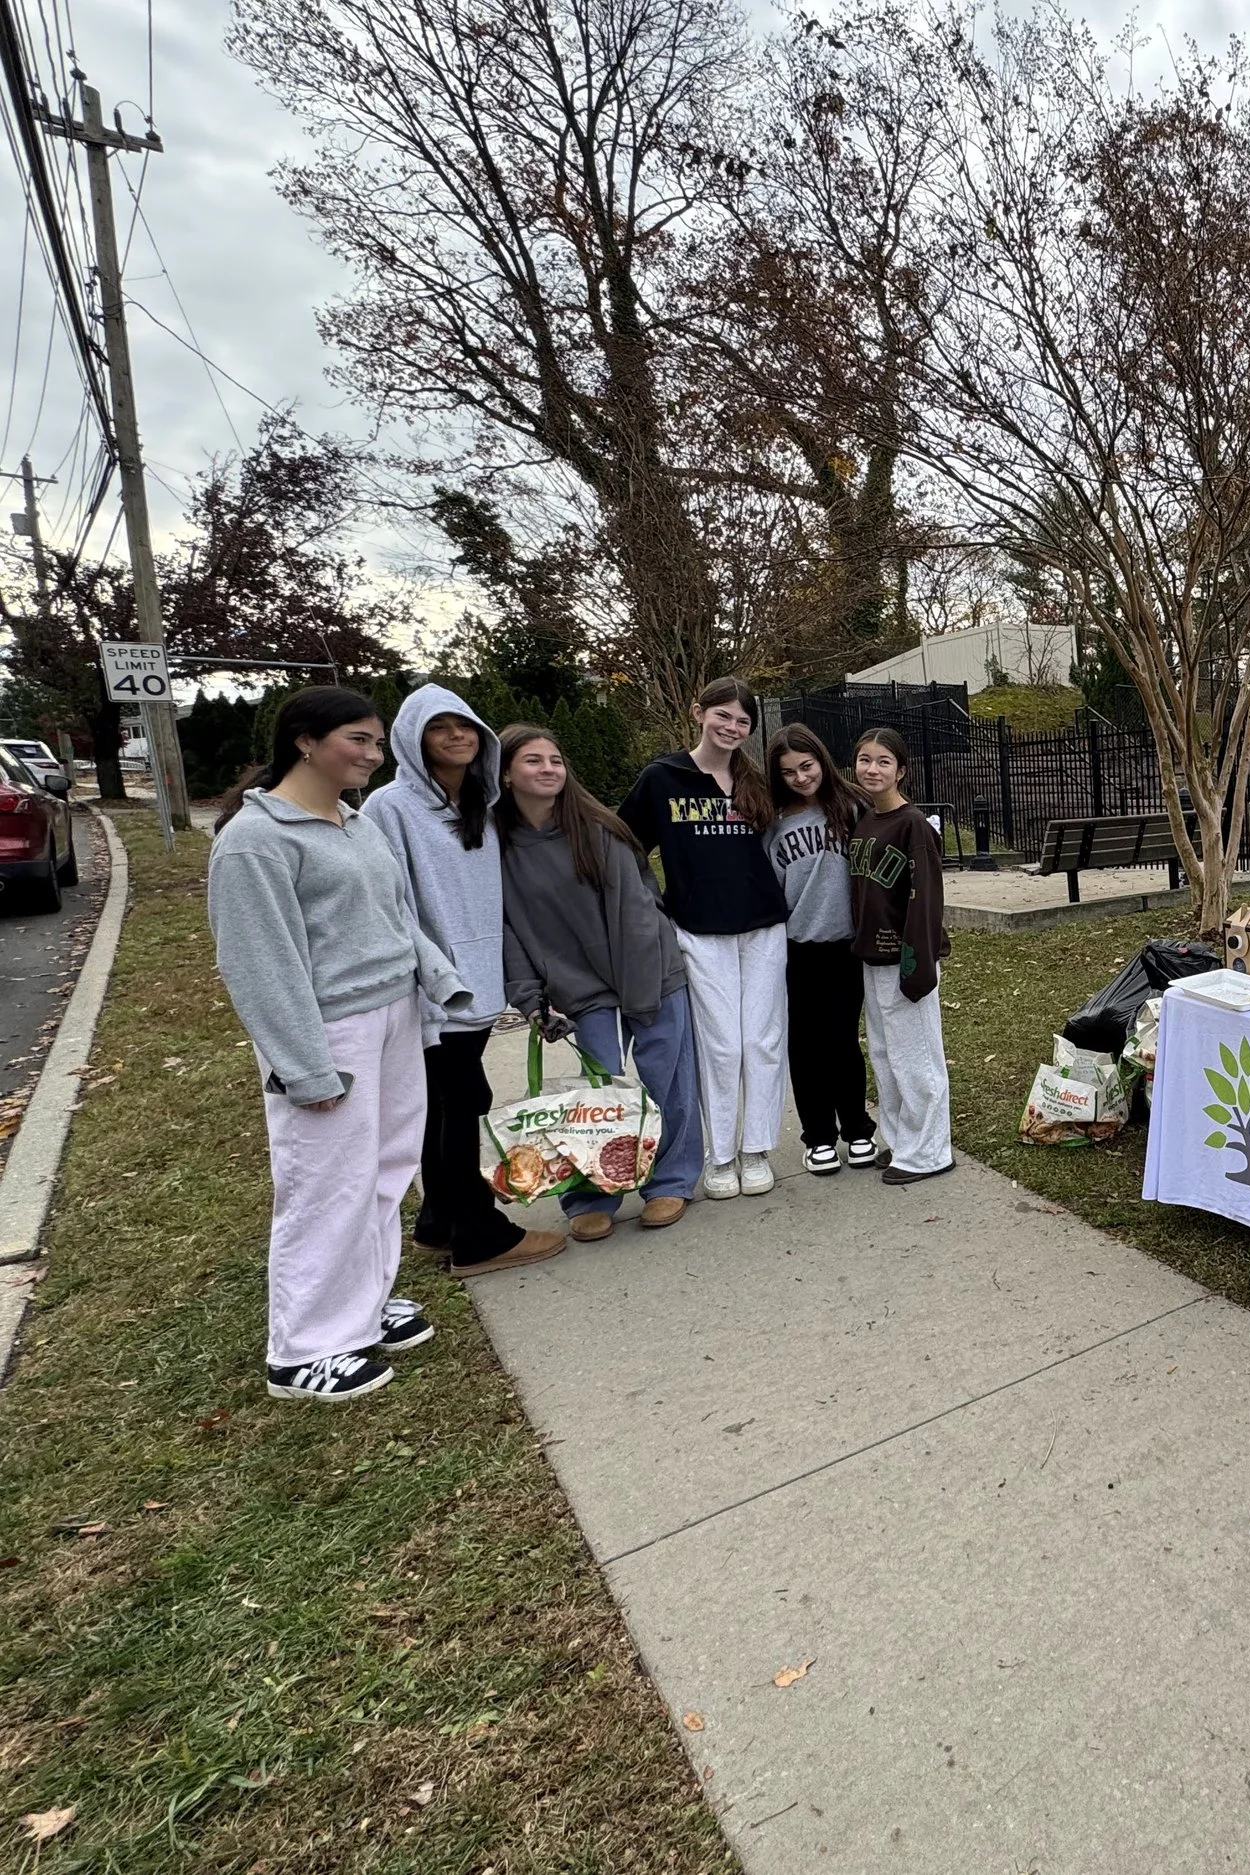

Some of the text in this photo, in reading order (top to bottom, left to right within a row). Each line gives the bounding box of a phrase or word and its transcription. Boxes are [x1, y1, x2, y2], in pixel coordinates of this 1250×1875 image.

[107, 648, 160, 659] SPEED
[115, 661, 156, 671] LIMIT
[113, 674, 166, 696] 40
[668, 798, 746, 822] MARYL
[507, 1101, 625, 1132] freshdirect
